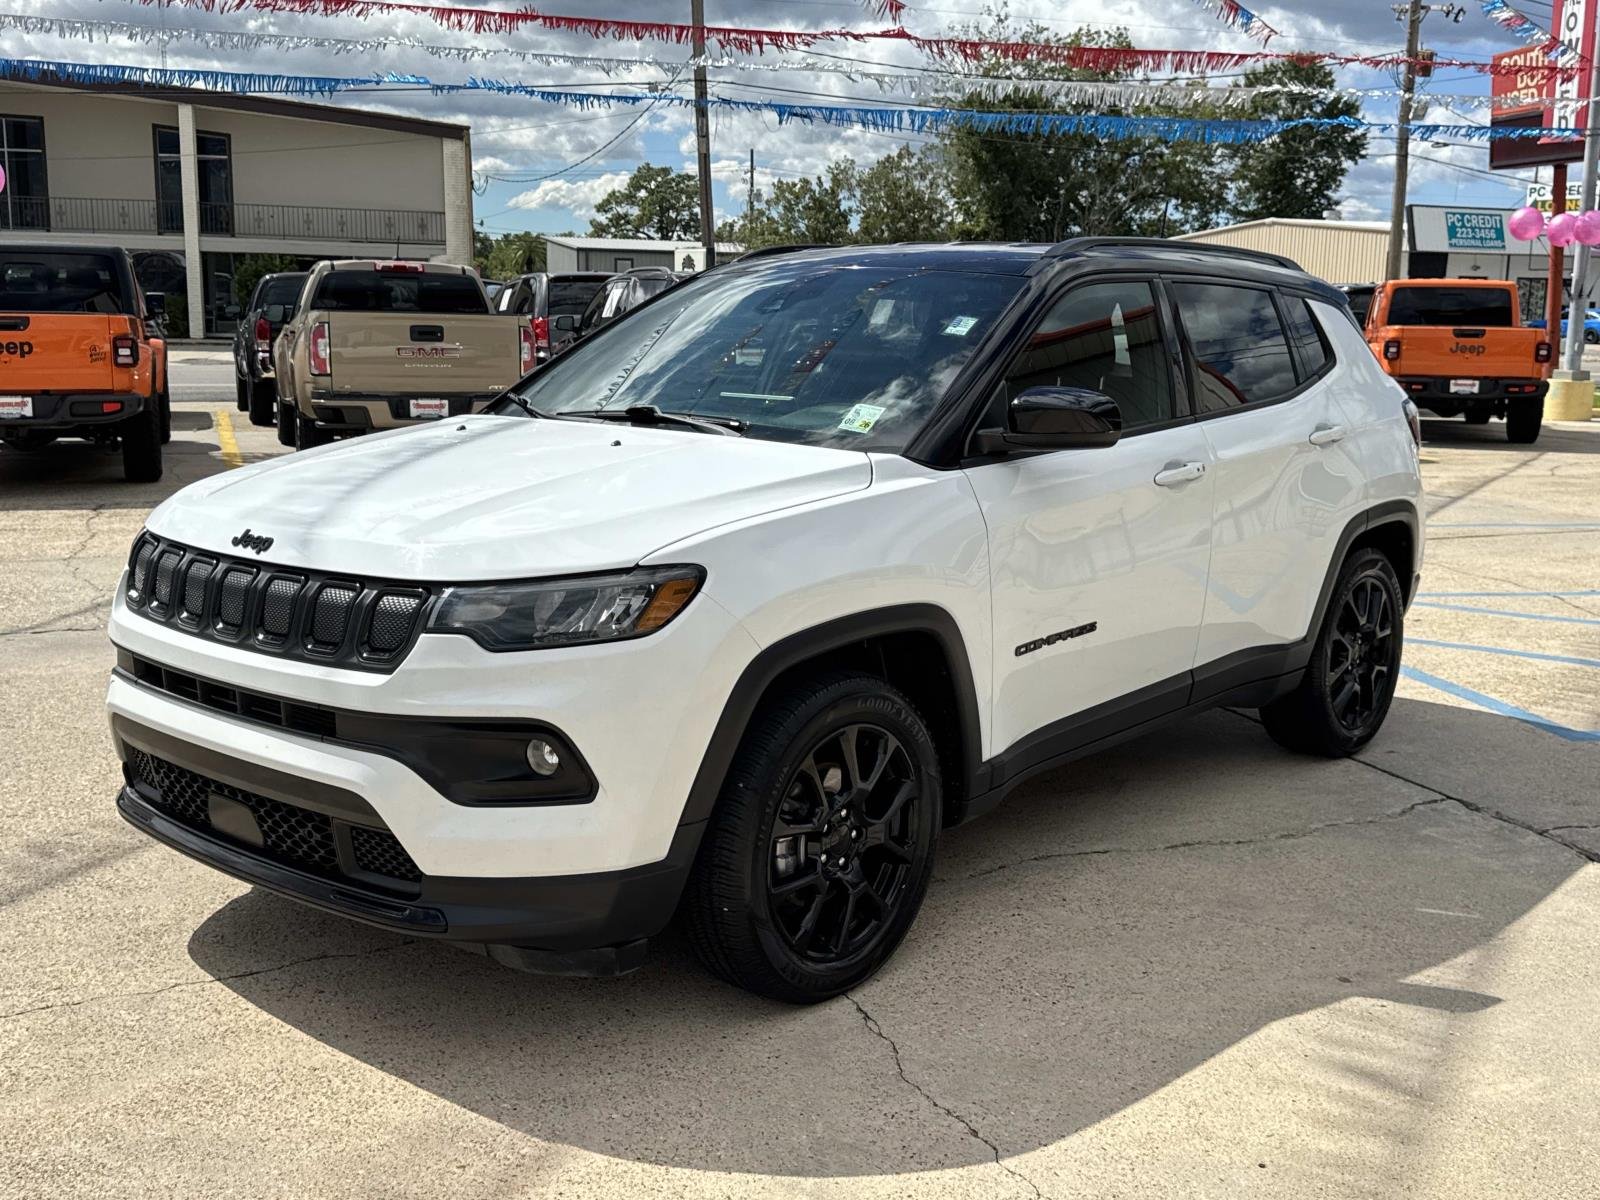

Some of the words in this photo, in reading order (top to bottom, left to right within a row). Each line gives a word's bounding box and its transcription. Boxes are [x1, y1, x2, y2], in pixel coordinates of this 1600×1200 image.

[1529, 186, 1546, 198] PC
[1447, 214, 1462, 226] PC
[1464, 214, 1501, 229] CREDIT
[1456, 228, 1496, 239] 223-3456
[396, 347, 460, 358] GMC
[1450, 342, 1486, 356] Jeep
[231, 528, 274, 555] Jeep
[1015, 621, 1097, 656] COMPASS
